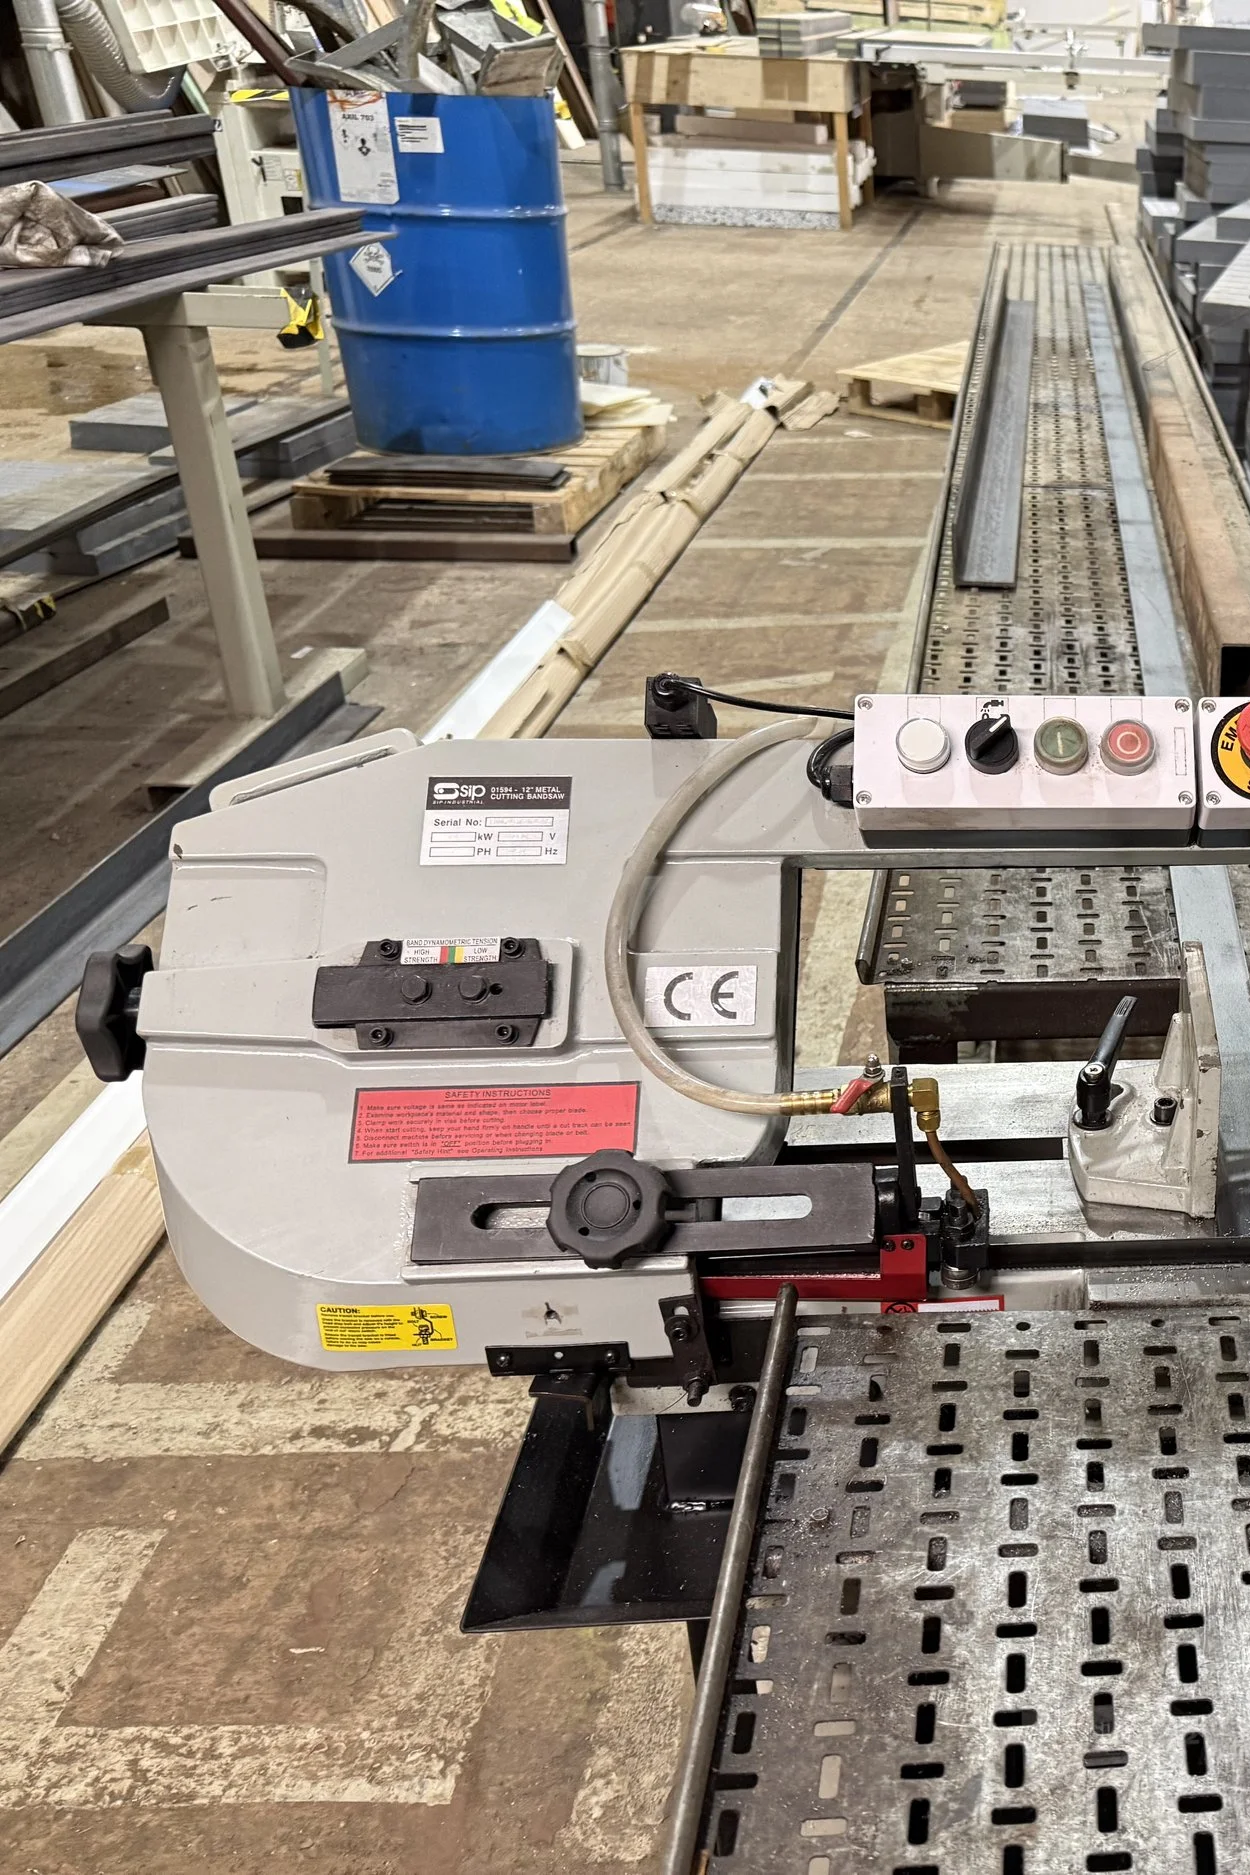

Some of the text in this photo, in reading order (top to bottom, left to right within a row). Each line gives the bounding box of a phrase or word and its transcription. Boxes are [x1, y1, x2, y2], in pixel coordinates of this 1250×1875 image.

[434, 818, 482, 827] Serial No:
[478, 833, 556, 841] kW V
[477, 848, 491, 856] PH
[663, 970, 739, 1021] CE
[445, 1089, 551, 1099] SAFETY INSTRUCTIONS
[320, 1306, 360, 1314] CAUTION:
